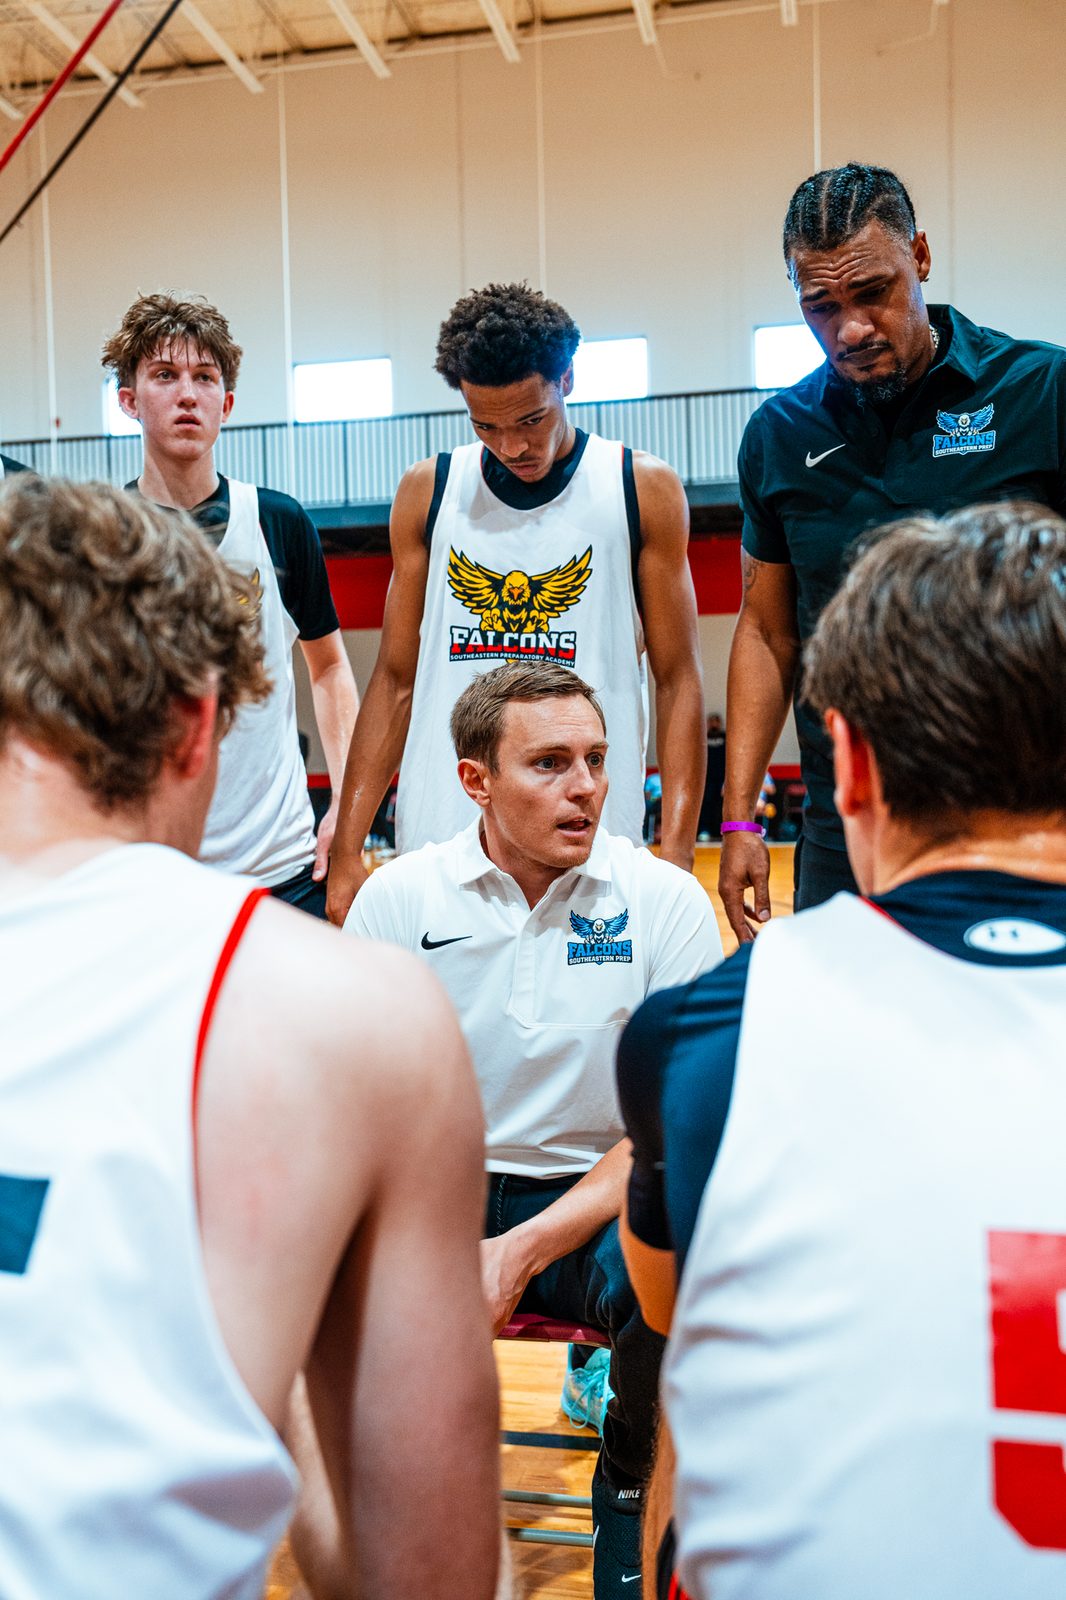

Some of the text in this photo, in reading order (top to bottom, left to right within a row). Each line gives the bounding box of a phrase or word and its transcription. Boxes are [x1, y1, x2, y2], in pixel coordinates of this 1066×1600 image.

[934, 431, 994, 449] FALCONS
[935, 445, 977, 455] SOUTHEASTERN
[450, 627, 576, 659] FALCONS
[450, 652, 576, 667] SOUTHEASTERN PREPARATORY ACADEMY
[568, 940, 632, 958] FALCONS
[569, 956, 615, 964] SOUTHEASTERN
[618, 1489, 640, 1499] NIKE
